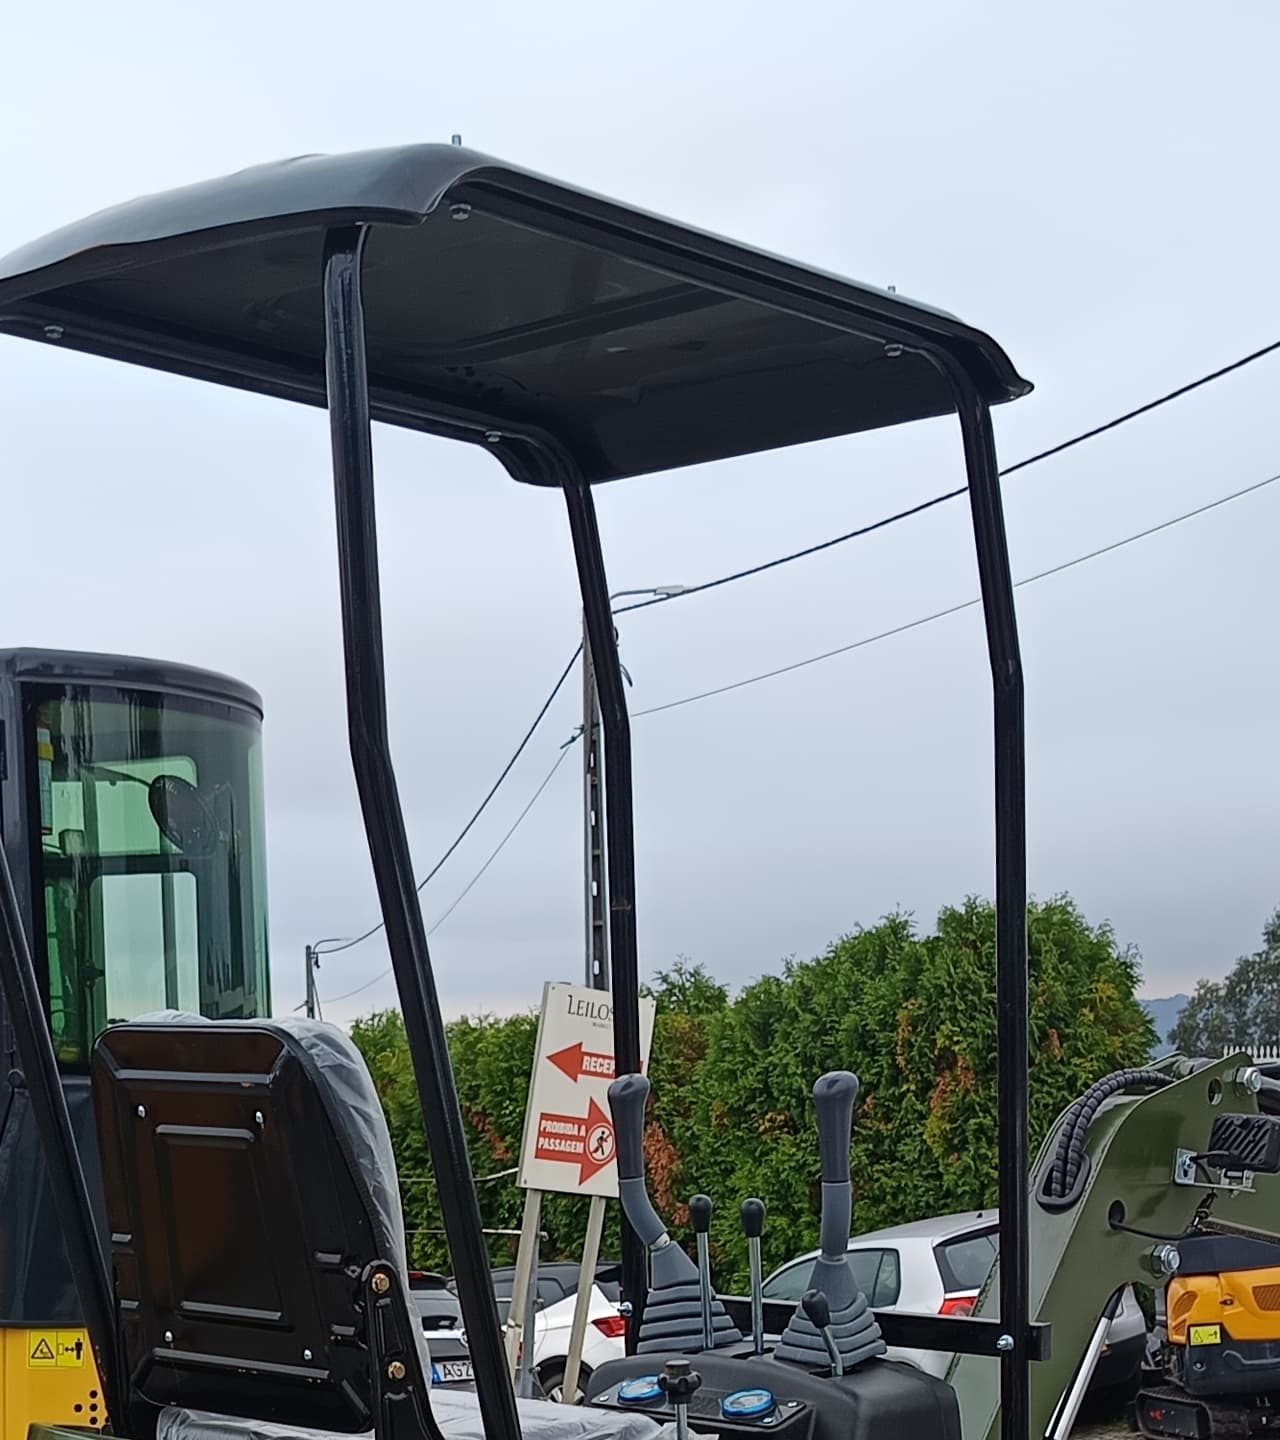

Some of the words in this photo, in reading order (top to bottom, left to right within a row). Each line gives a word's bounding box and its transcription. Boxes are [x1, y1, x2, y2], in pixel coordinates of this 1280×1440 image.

[582, 1055, 615, 1075] RECEP
[579, 1124, 587, 1137] A
[538, 1137, 584, 1154] PASSAGEM
[443, 1361, 473, 1379] AG2
